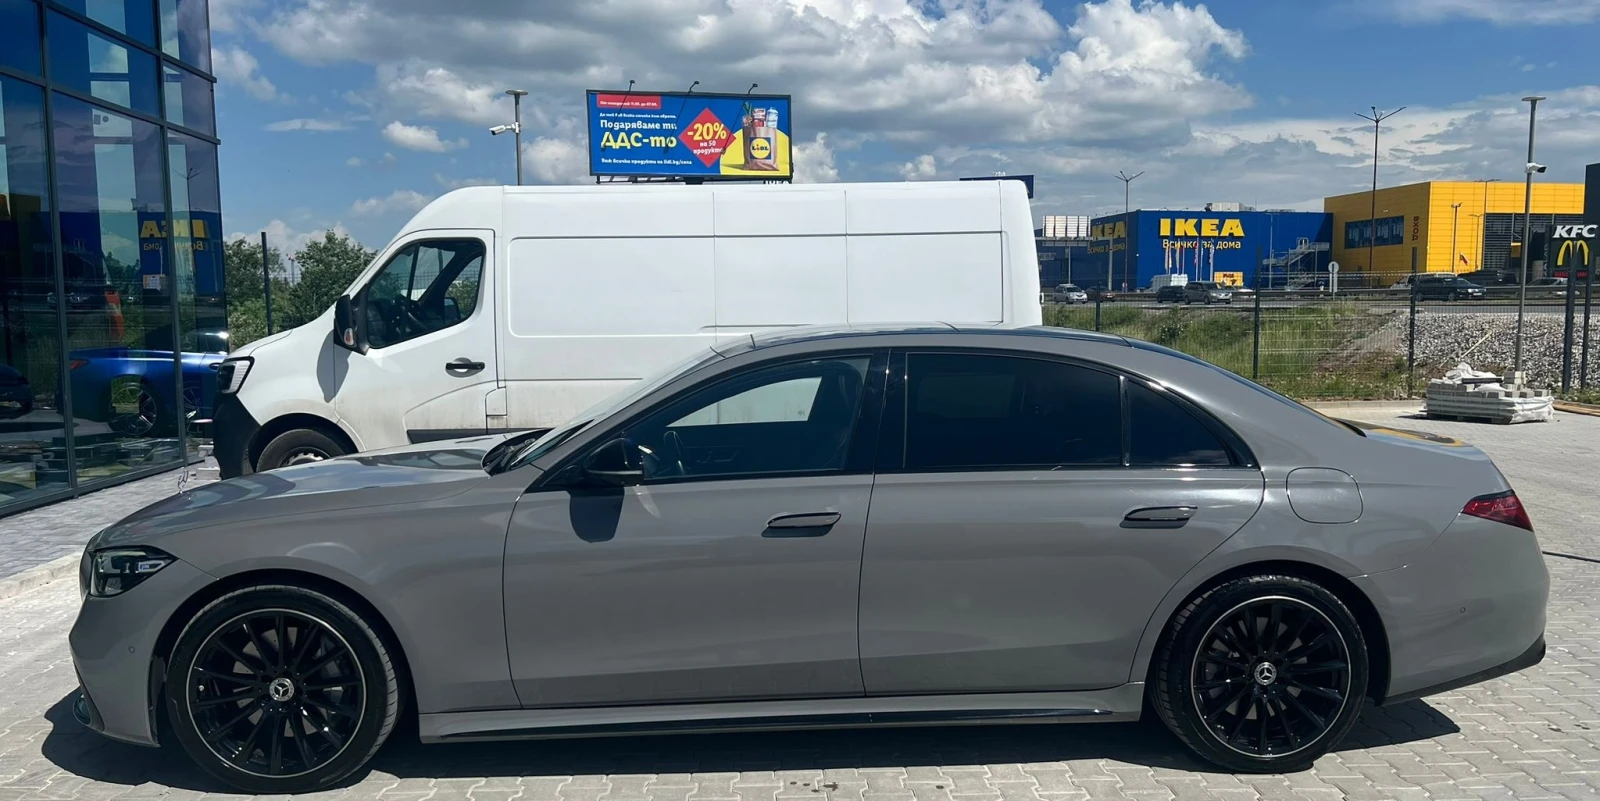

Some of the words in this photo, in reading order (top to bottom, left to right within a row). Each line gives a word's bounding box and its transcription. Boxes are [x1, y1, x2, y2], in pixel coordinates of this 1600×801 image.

[600, 119, 661, 130] Подаряваме
[687, 122, 727, 141] -20%
[601, 131, 677, 149] ДДС-то
[1160, 218, 1245, 237] IKEA
[1552, 224, 1599, 238] KFC
[1216, 241, 1241, 250] дома
